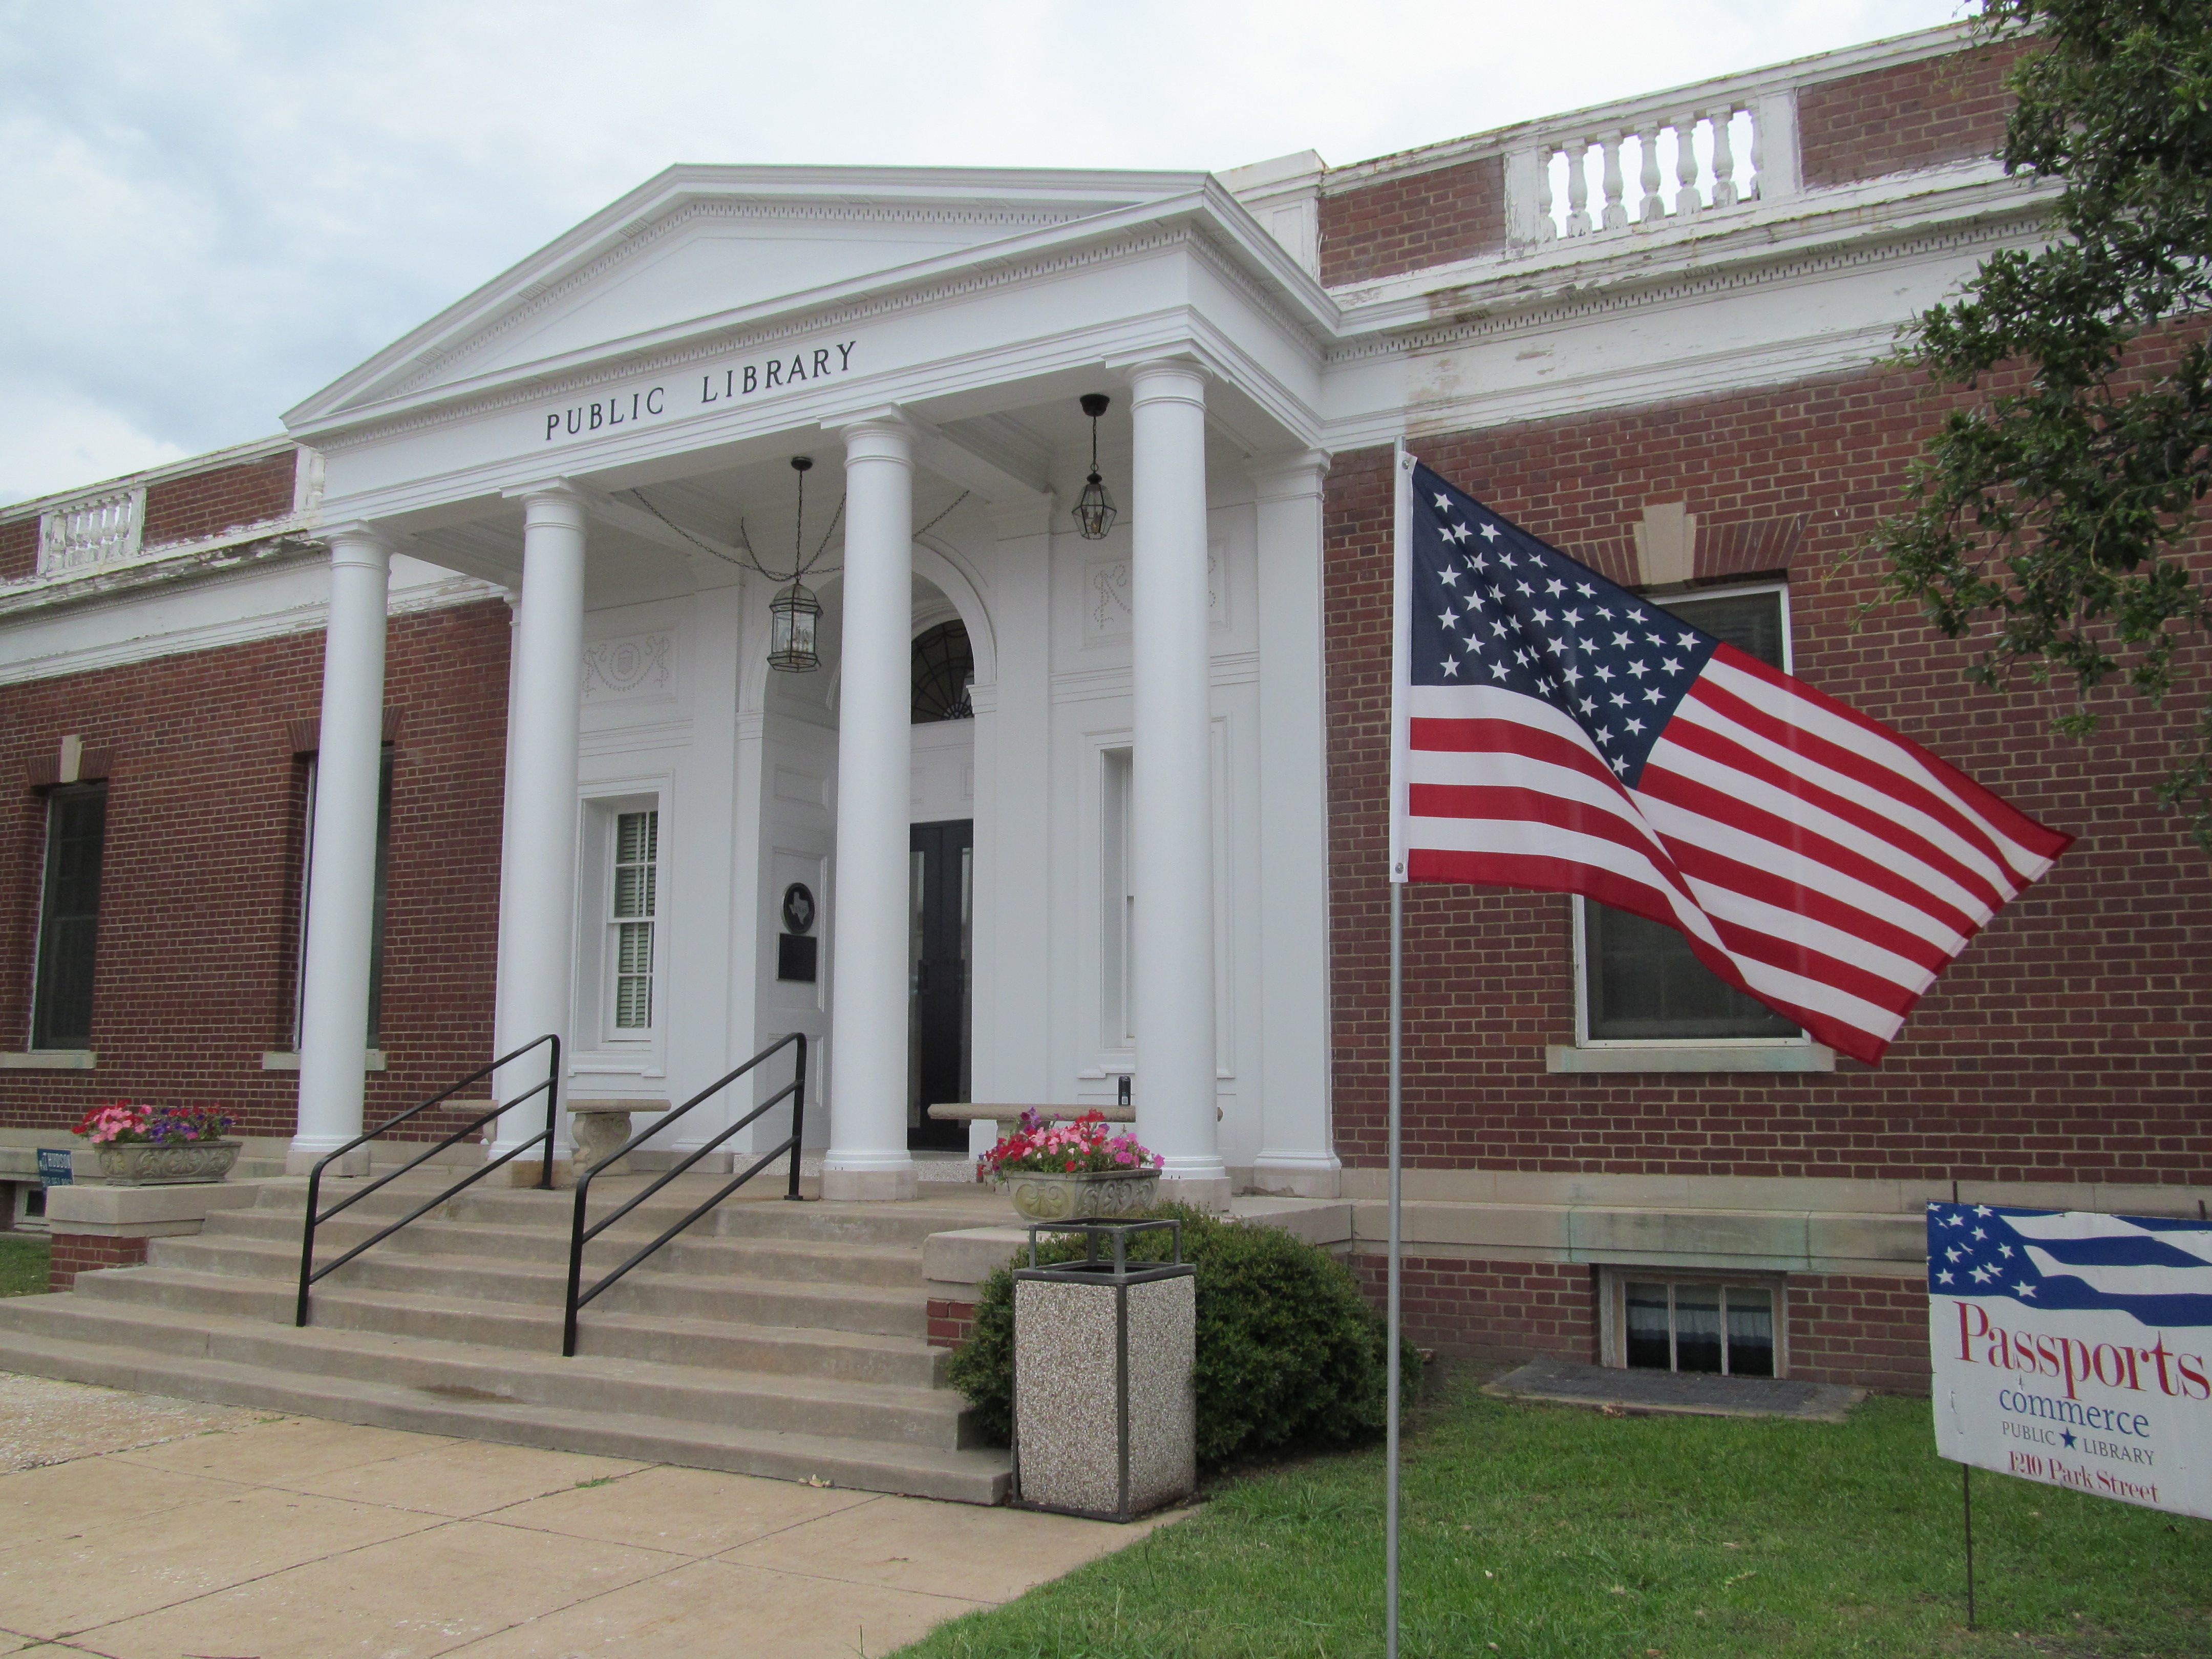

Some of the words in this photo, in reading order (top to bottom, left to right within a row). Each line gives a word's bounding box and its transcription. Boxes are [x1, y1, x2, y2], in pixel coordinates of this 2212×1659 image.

[546, 387, 665, 441] PUBLIC
[701, 341, 856, 403] LIBRARY
[1953, 1301, 2210, 1401] Passports
[1999, 1389, 2151, 1438] commerce
[2002, 1421, 2056, 1445] PUBLIC
[2082, 1438, 2154, 1465] LIBRARY
[2008, 1451, 2043, 1476] 1210
[2048, 1458, 2094, 1488] Park
[2096, 1469, 2160, 1504] Street
